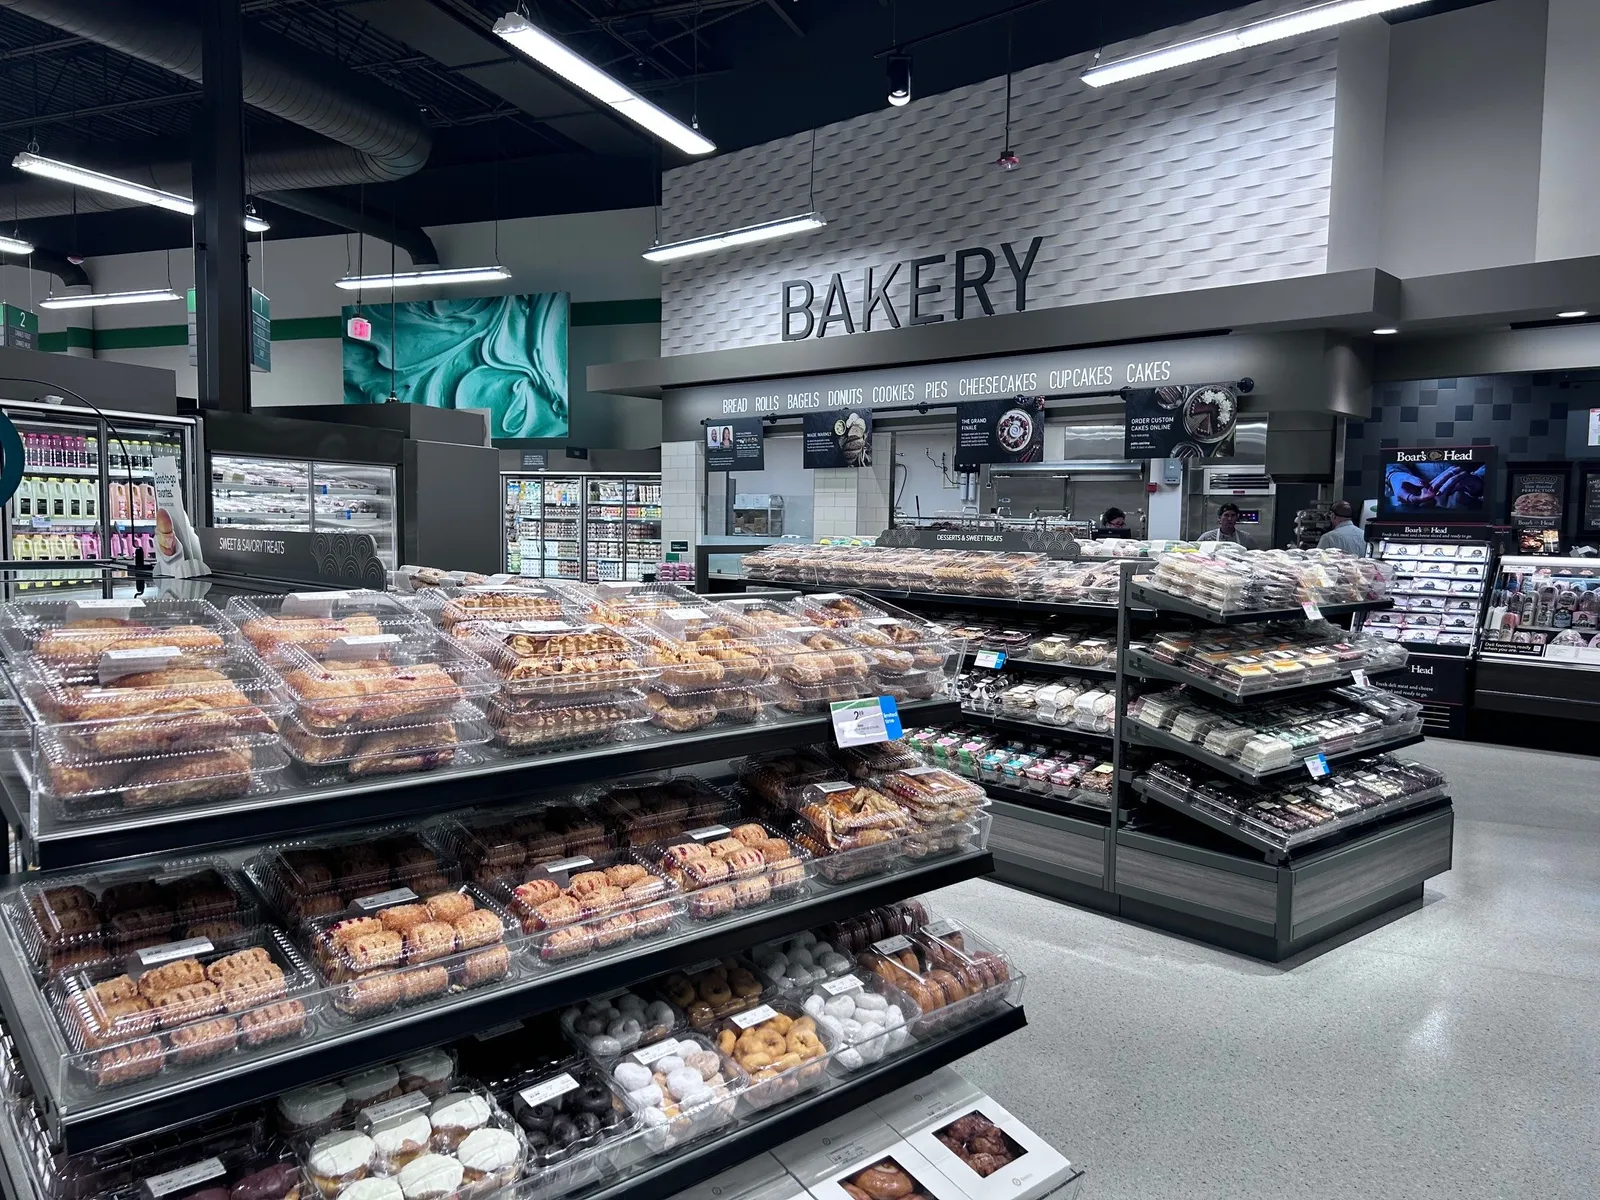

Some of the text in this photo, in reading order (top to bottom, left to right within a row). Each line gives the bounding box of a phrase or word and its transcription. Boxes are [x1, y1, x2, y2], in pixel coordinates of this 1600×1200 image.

[781, 236, 1043, 341] BAKERY
[20, 312, 26, 328] 2
[722, 360, 1171, 414] BREAD ROLLS BAGELS DONUTS COOKIES PIES CHEESECAKES CUPCAKES CAKES
[1397, 449, 1472, 462] Boar's Head
[219, 538, 237, 550] SWEET
[242, 540, 264, 552] SAVORY
[264, 541, 284, 554] TREATS
[1411, 665, 1433, 675] Head
